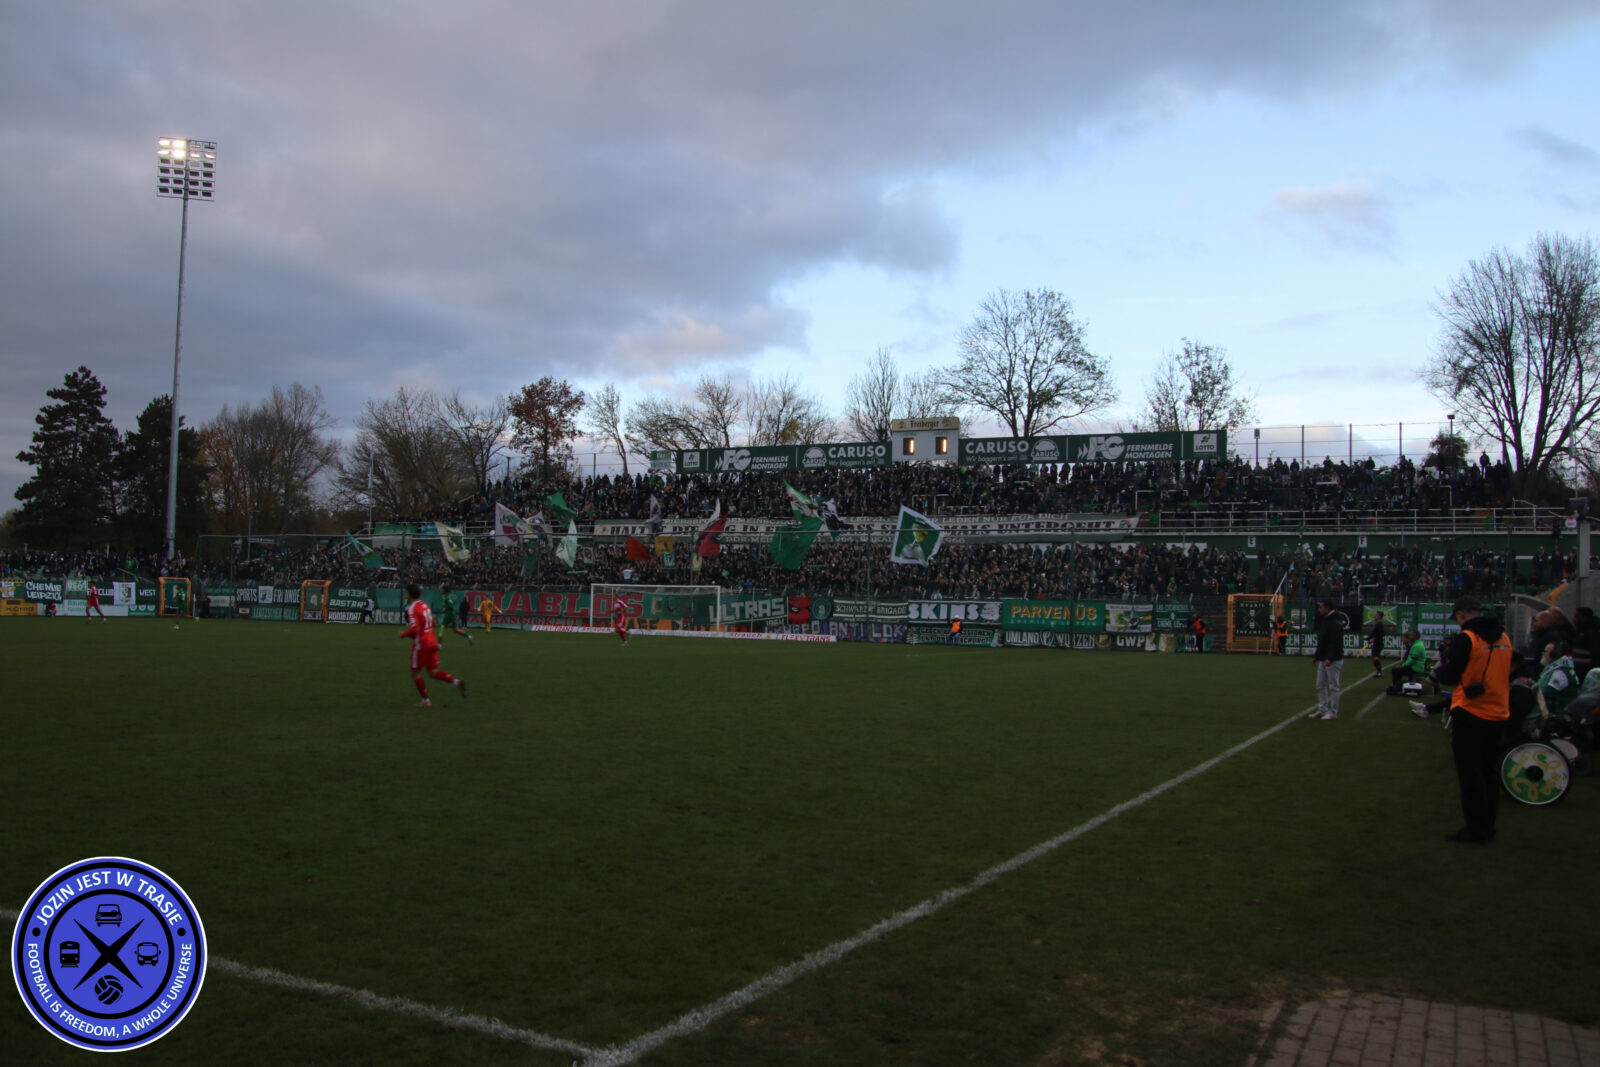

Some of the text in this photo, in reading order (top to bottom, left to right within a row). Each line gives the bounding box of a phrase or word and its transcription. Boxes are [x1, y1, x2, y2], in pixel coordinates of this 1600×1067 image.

[828, 445, 886, 458] CARUSO
[965, 440, 1029, 454] CARUSO
[1127, 443, 1174, 451] FERNMELDE
[752, 455, 789, 463] FERNMELDE
[1030, 450, 1060, 458] CARUSO
[1125, 451, 1172, 459] MONTAGEN
[802, 457, 827, 465] CARUSO
[1038, 512, 1068, 520] DICH
[25, 581, 62, 592] CHEMIE
[26, 590, 62, 601] LEIPZIG
[140, 589, 157, 597] WEST
[236, 588, 258, 603] SPORTS
[465, 591, 644, 619] DIABLOS
[877, 605, 907, 614] BRIGADE
[708, 598, 785, 624] ULTRAS
[908, 603, 980, 621] SKINS
[1005, 631, 1040, 644] UMLAND
